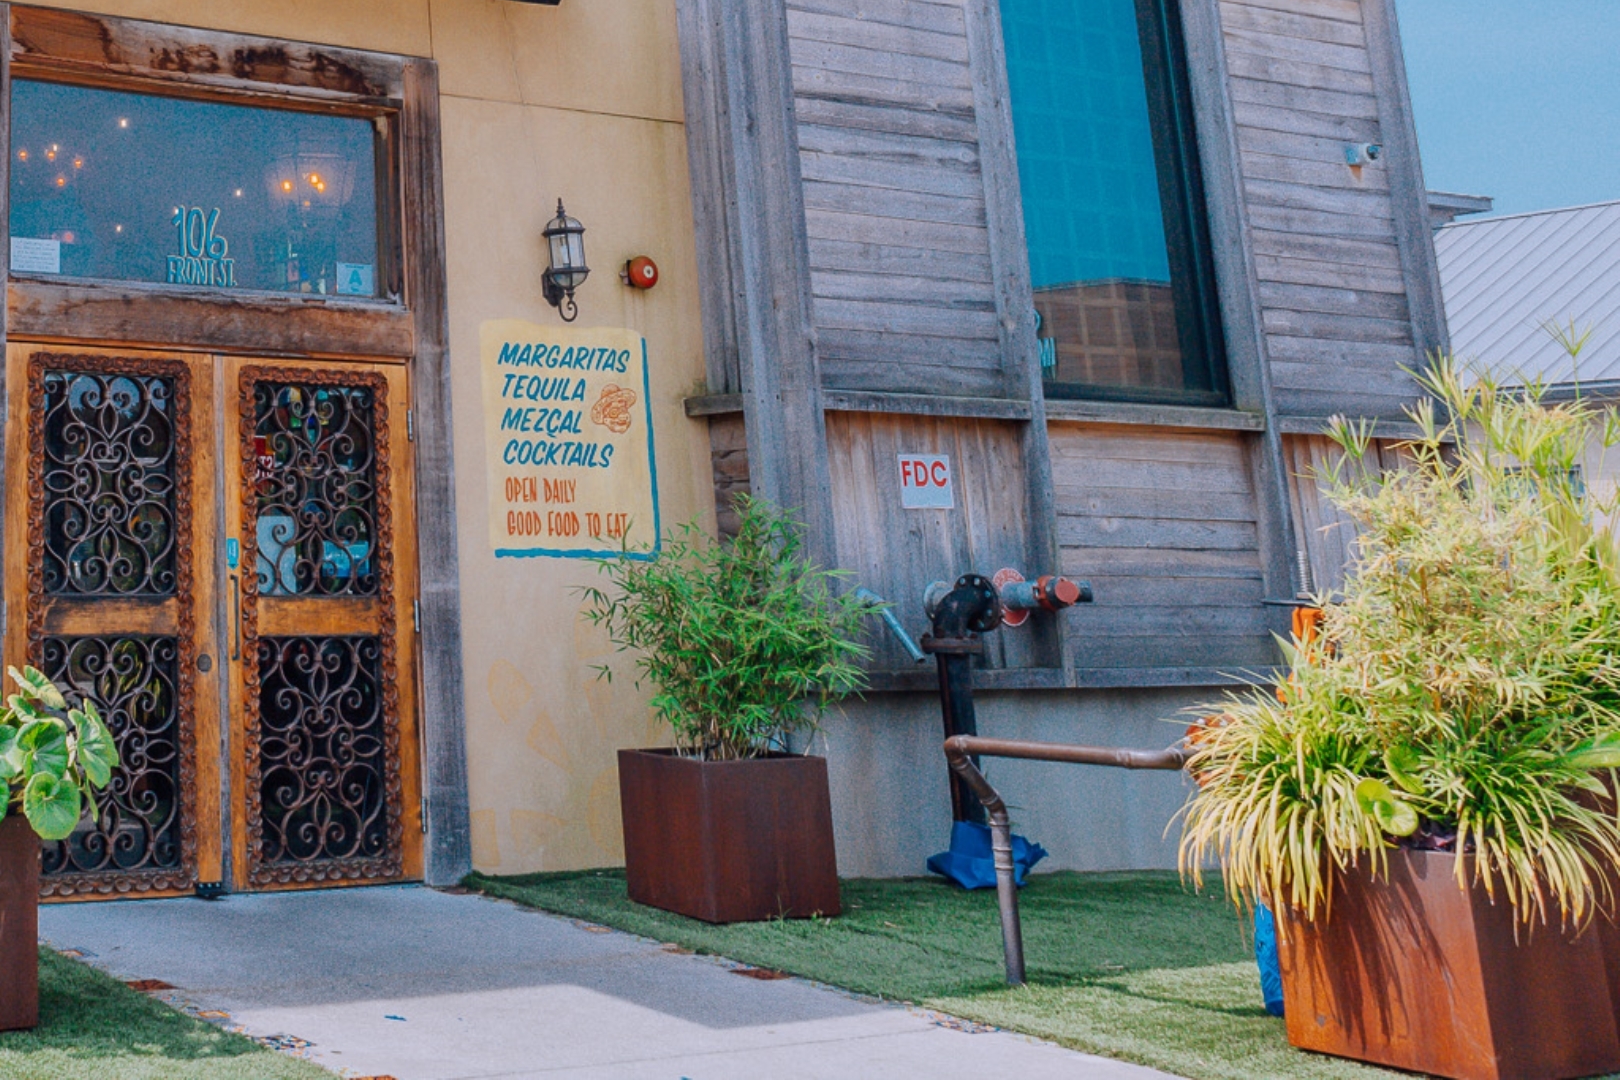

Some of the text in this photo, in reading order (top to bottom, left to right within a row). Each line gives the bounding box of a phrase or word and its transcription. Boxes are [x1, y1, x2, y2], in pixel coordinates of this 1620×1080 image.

[171, 205, 228, 259] 106
[166, 255, 216, 286] FRONT
[497, 342, 630, 373] MARGARITAS
[501, 374, 586, 402] TEQUILA
[503, 439, 614, 468] COCKTAILS
[901, 460, 948, 487] FDC
[505, 477, 577, 504] OPEN DAILY
[507, 510, 628, 538] GOOD FOOD TO EAT
